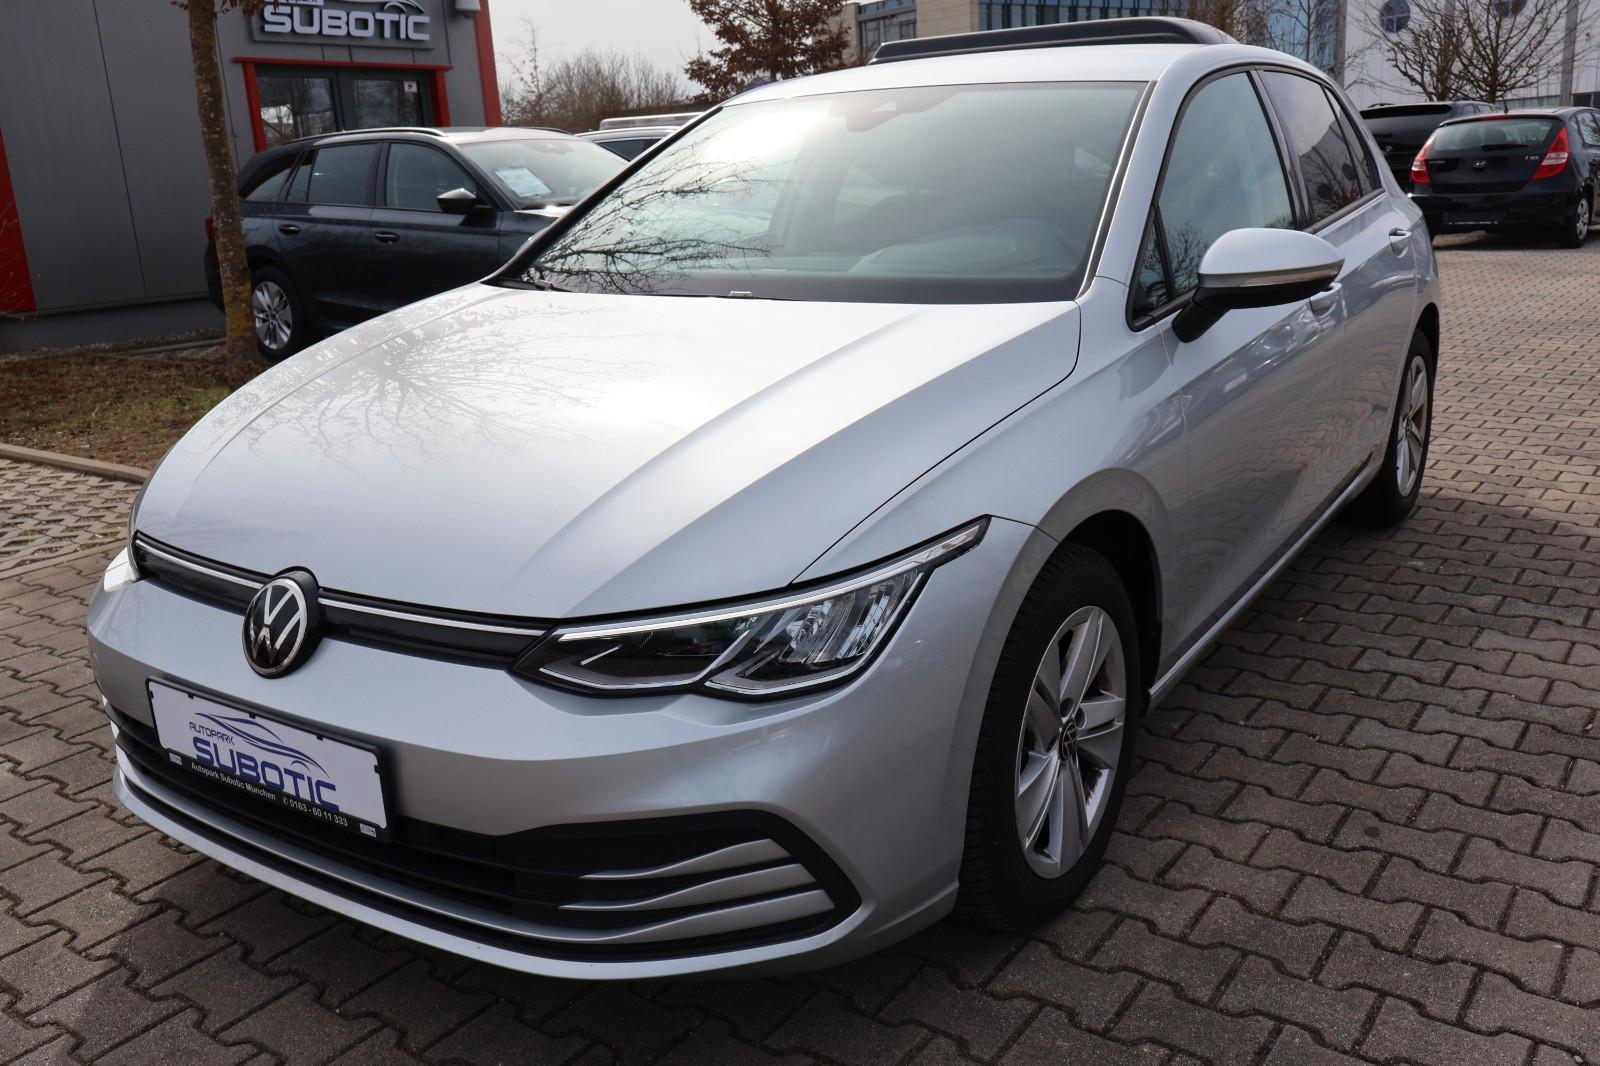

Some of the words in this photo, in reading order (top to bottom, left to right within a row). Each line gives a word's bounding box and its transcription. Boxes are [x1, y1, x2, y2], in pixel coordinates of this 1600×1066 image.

[264, 5, 430, 41] SUBOTIC
[189, 722, 235, 746] AUTOPARK
[192, 737, 340, 812] SUBOTIC
[219, 772, 245, 789] Subotic
[324, 811, 332, 821] 11
[333, 814, 347, 827] 333
